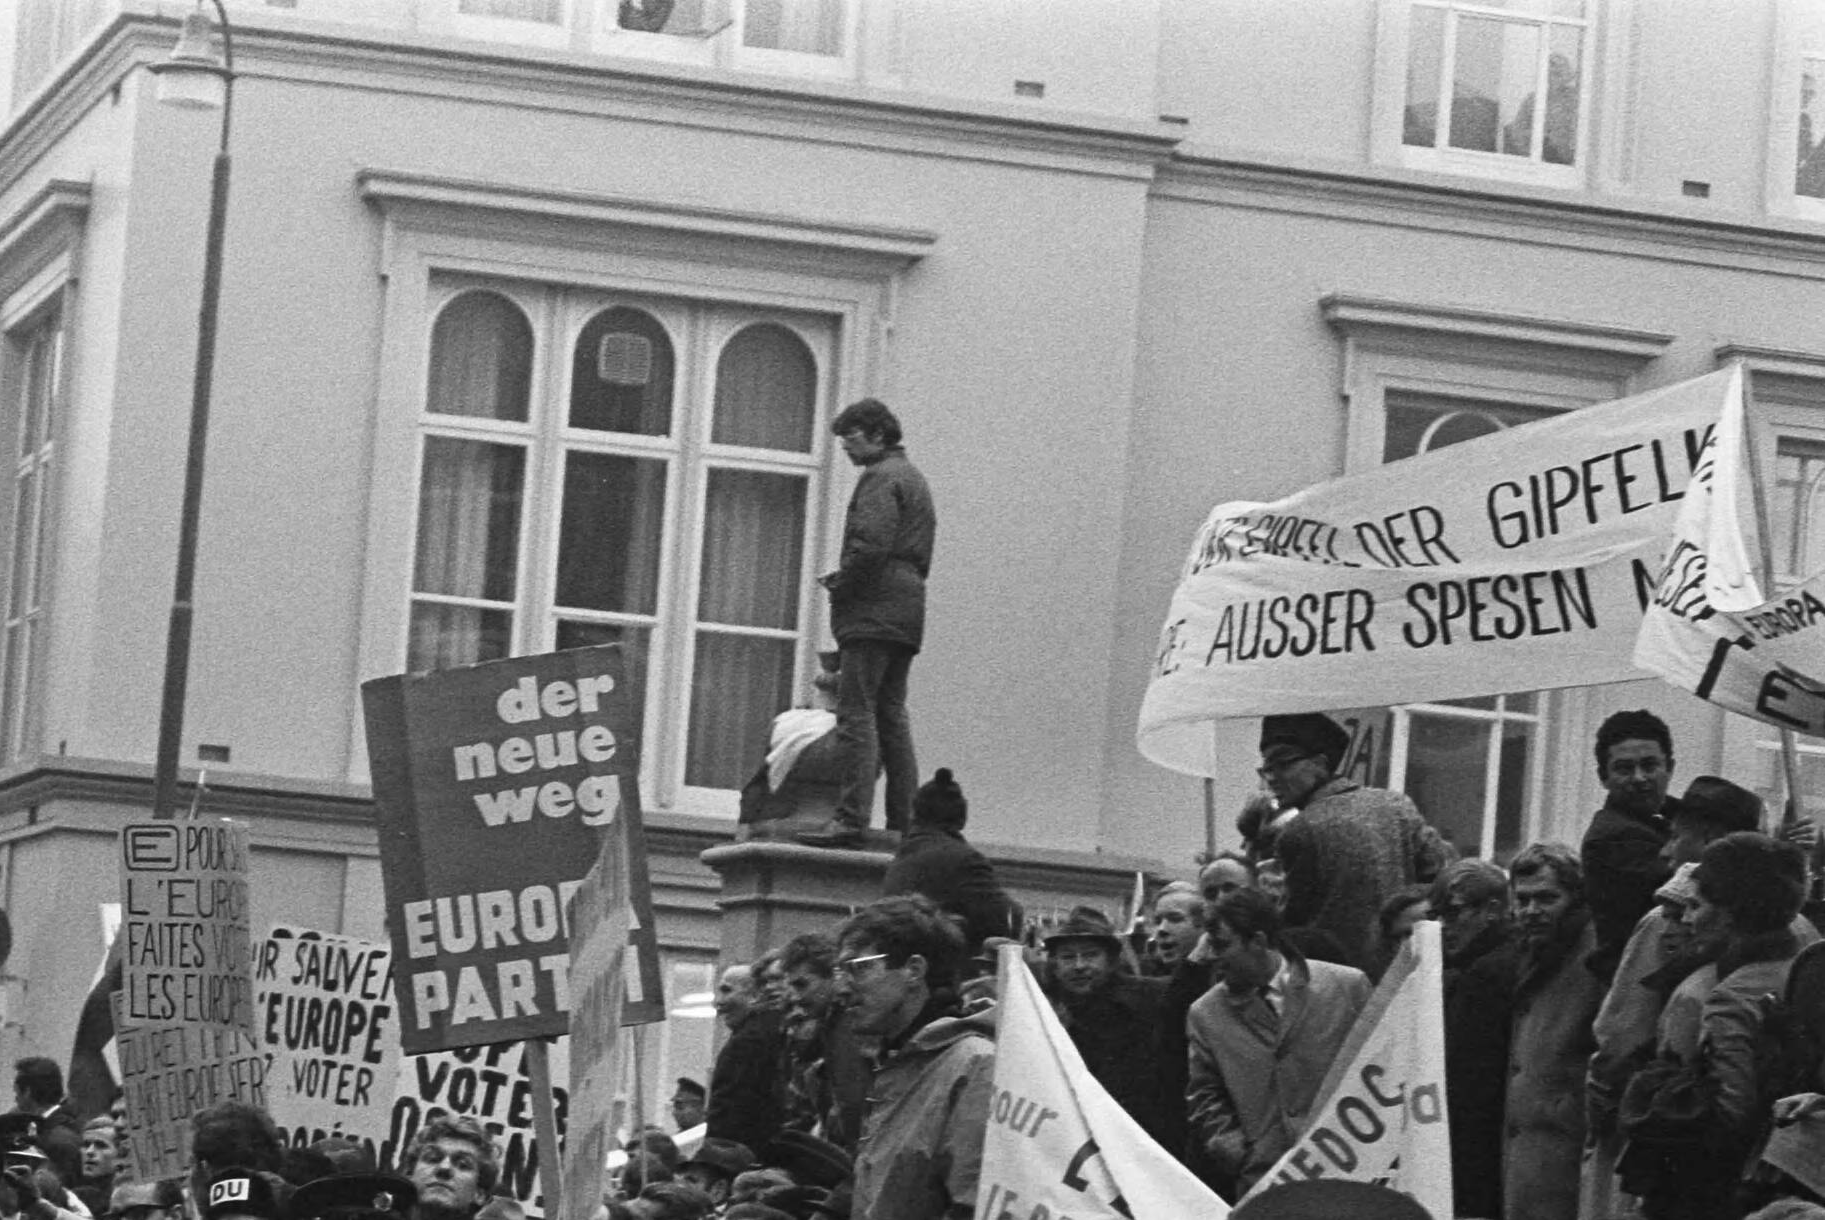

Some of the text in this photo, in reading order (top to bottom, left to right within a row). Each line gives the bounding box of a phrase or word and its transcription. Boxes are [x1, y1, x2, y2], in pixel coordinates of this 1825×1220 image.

[1206, 588, 1376, 667] AUSSER
[1403, 566, 1598, 649] SPESEN
[496, 674, 615, 724] der
[453, 725, 616, 781] neue
[473, 774, 620, 826] weg
[127, 921, 205, 969] FAITES
[130, 973, 176, 1020] LES
[258, 991, 391, 1064] 'EUROPE
[292, 1057, 373, 1107] VOTER
[994, 1089, 1059, 1138] our
